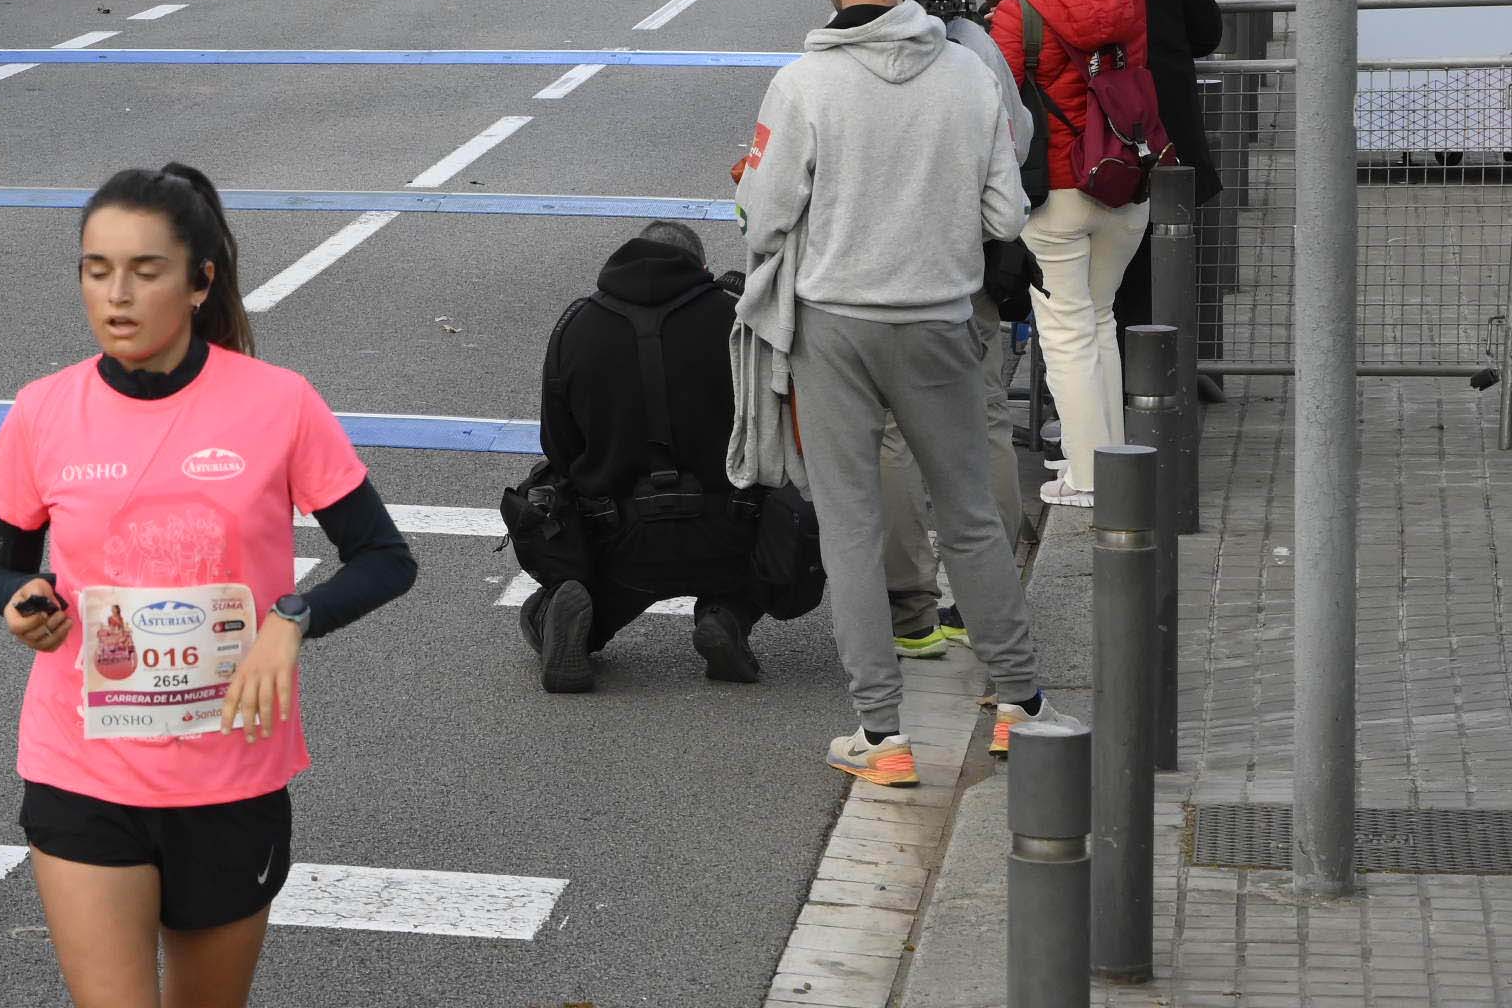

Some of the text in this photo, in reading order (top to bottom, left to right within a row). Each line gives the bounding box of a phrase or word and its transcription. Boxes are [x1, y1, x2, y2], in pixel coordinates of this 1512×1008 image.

[62, 463, 127, 481] OYSHO
[212, 602, 243, 612] SUMA
[136, 613, 201, 628] ASTURIANA
[142, 646, 199, 668] 016
[153, 674, 189, 688] 2654
[105, 689, 216, 703] CARRERA DE LA MUJER
[101, 714, 153, 727] OYSHO
